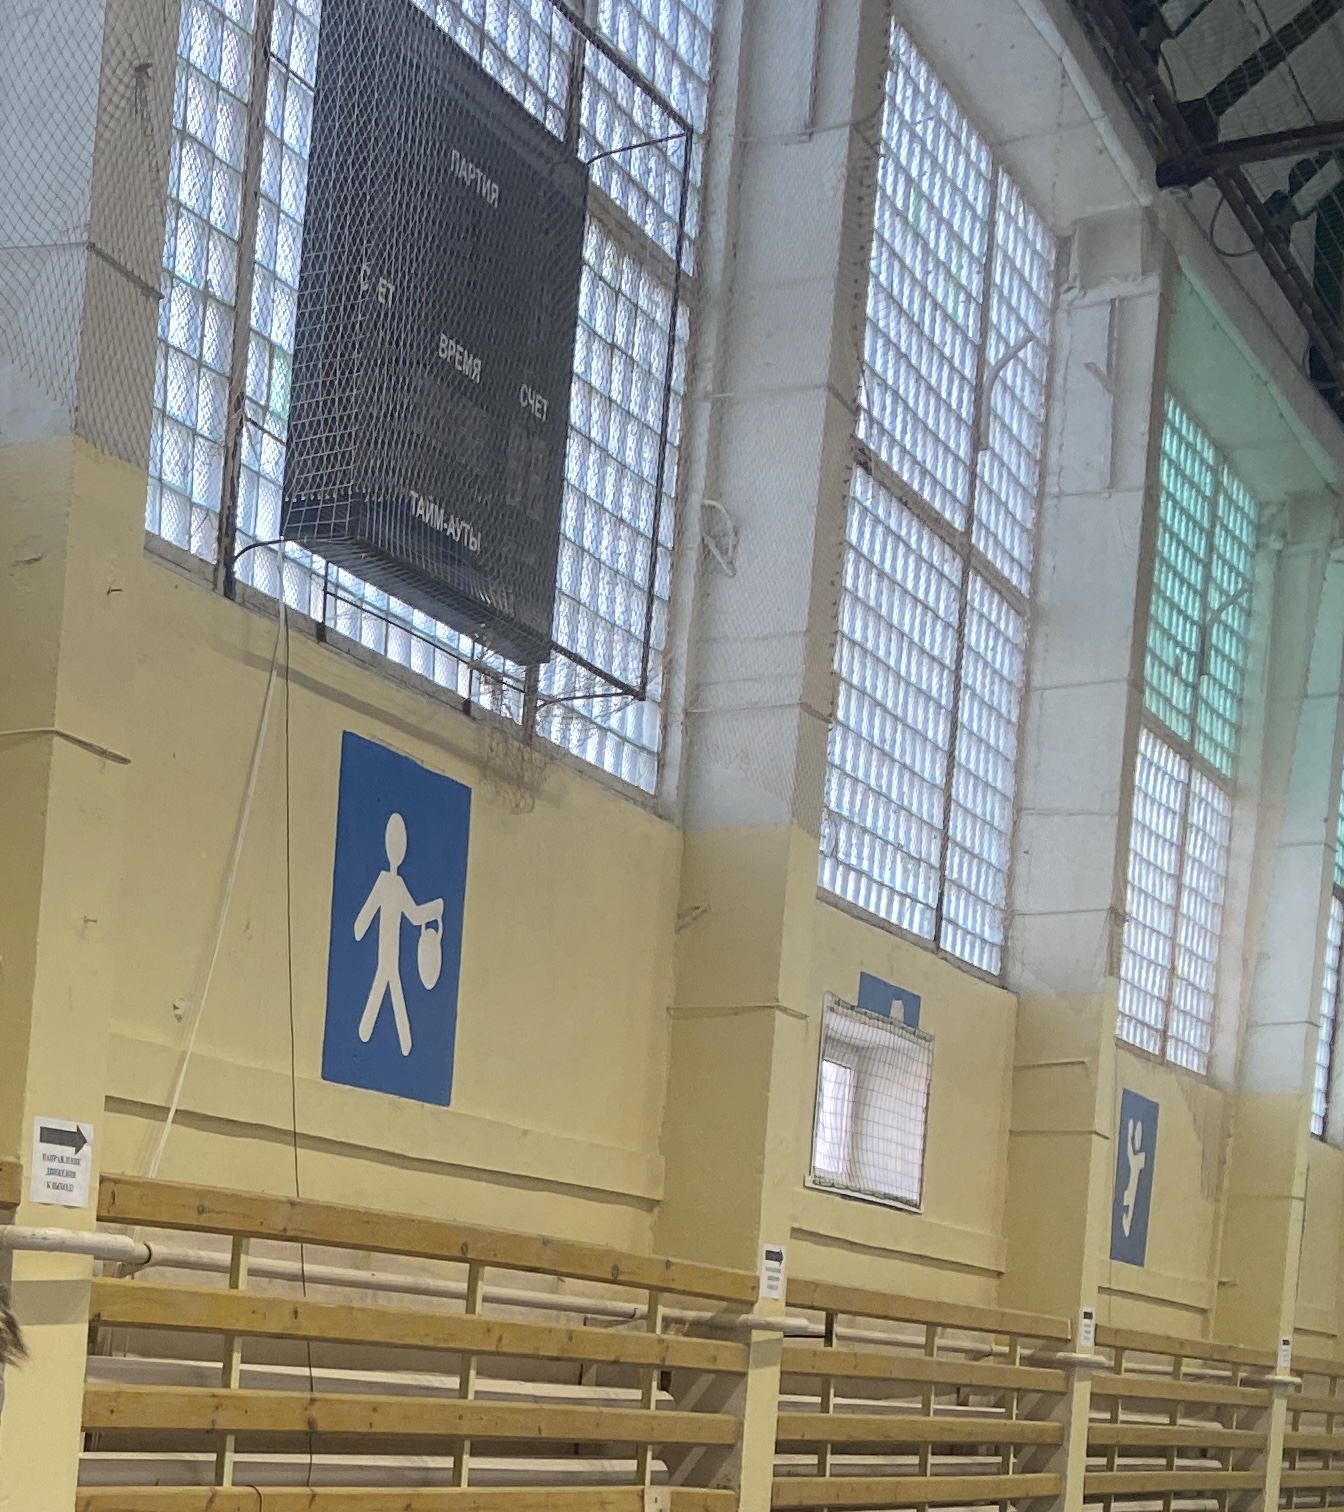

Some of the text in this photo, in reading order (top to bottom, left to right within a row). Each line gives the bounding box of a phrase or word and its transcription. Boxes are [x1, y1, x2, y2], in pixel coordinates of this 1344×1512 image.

[450, 149, 499, 208] ПАРТИЯ
[360, 263, 395, 308] СЕТ
[439, 333, 481, 384] ВРЕМЯ
[520, 383, 548, 422] СЧЕТ
[409, 490, 481, 556] ТАЙМ-АУТЫ
